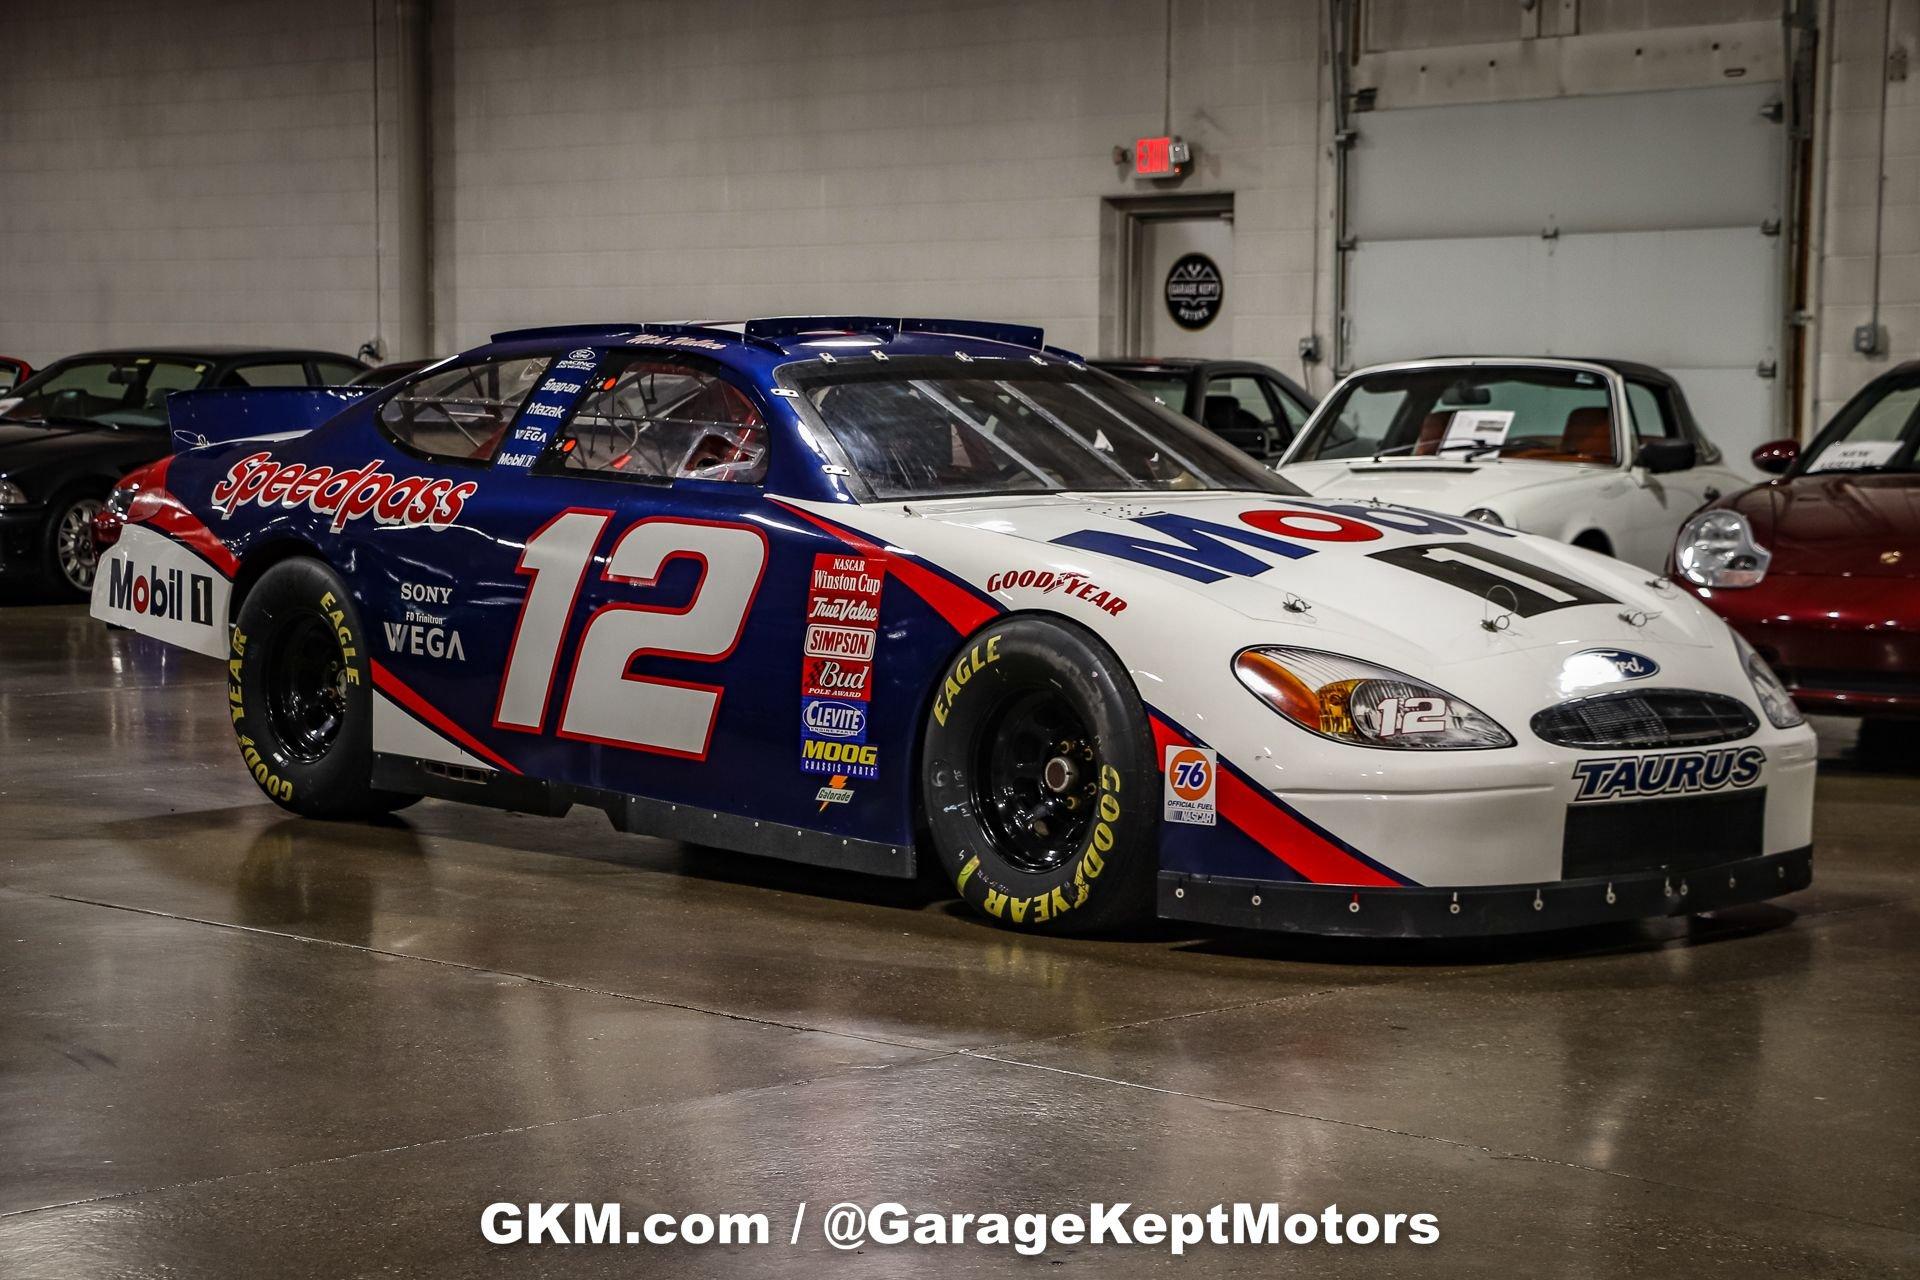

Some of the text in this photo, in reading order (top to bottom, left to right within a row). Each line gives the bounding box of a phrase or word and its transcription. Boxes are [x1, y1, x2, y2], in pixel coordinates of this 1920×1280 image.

[541, 378, 581, 394] Snap-on
[526, 402, 566, 419] Mazak
[497, 452, 525, 467] Mobil
[210, 451, 478, 534] Speedpass
[832, 558, 866, 572] NASCAR
[109, 557, 214, 627] Mobil 1
[400, 582, 453, 604] SONY
[814, 569, 881, 596] Winston Cup
[986, 569, 1128, 617] GOODYEAR
[415, 612, 443, 625] Trinitron
[320, 591, 360, 686] EAGLE
[492, 506, 770, 762] 12
[810, 629, 870, 655] SIMPSON
[819, 661, 870, 690] Bud
[932, 634, 1002, 727] EAGLE
[807, 687, 862, 698] POLE AWARD
[806, 700, 862, 730] CLEVITE
[1376, 697, 1448, 738] 12
[802, 739, 879, 766] MOOG
[805, 760, 875, 777] CHASSIS PARTS
[1174, 760, 1207, 791] 76
[1571, 746, 1767, 802] TAURUS
[818, 788, 853, 802] Gatorade
[1167, 800, 1214, 811] OFFICIAL FUEL
